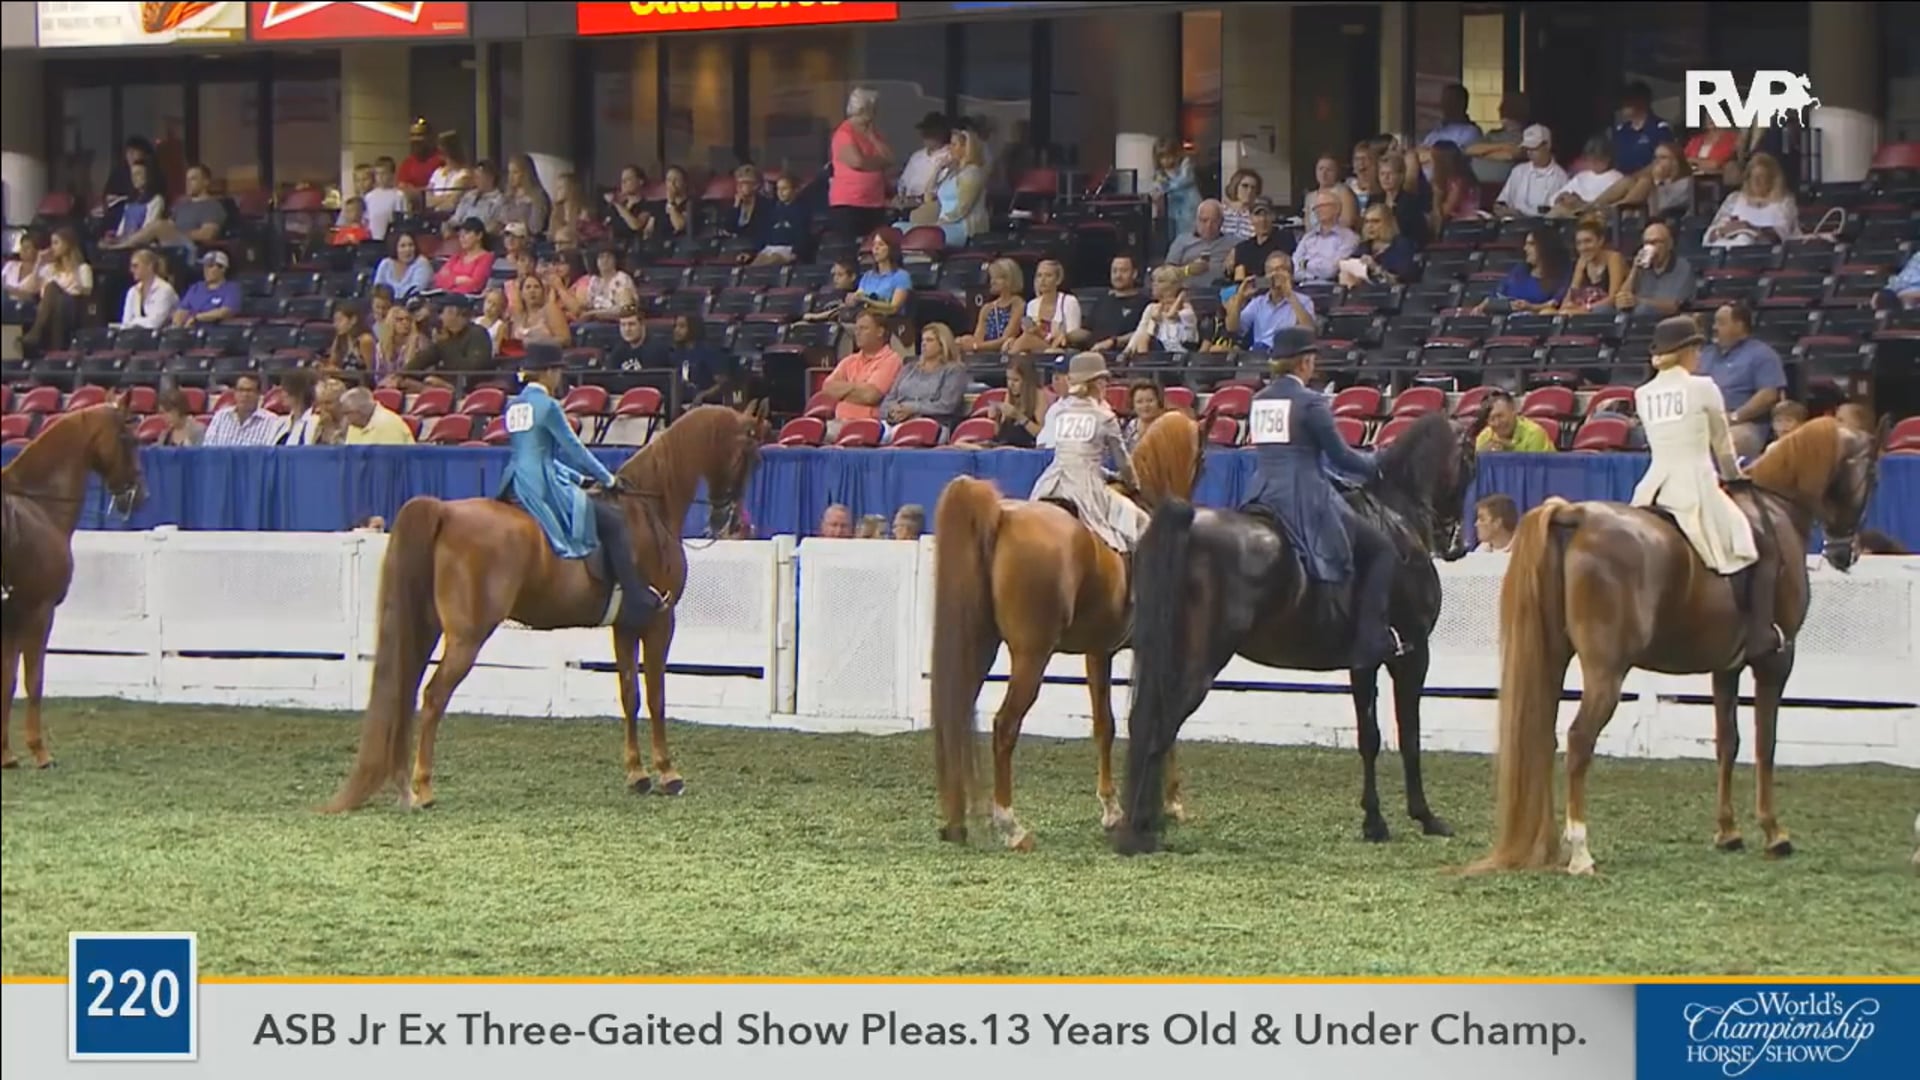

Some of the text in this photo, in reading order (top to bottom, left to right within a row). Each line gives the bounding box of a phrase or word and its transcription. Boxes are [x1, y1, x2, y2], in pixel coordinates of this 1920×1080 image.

[1647, 391, 1684, 421] 1178
[1057, 416, 1093, 439] 1260
[1254, 408, 1284, 433] 1758
